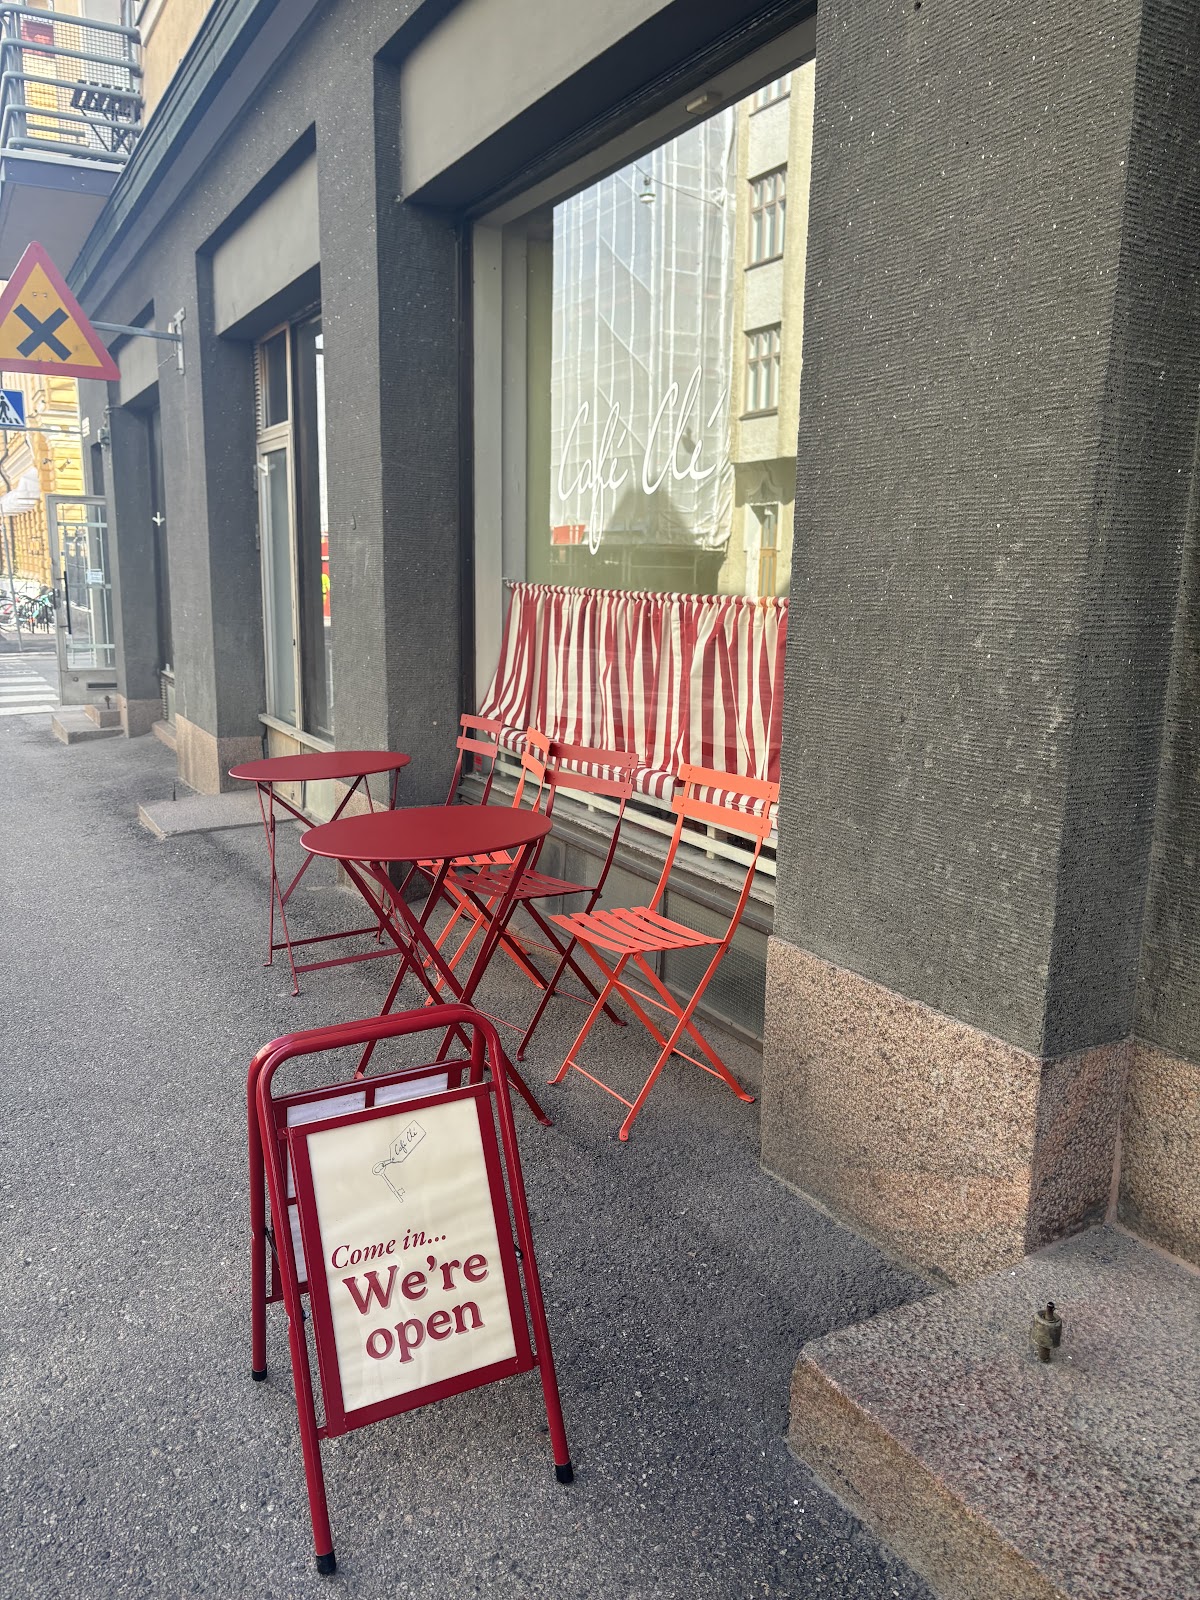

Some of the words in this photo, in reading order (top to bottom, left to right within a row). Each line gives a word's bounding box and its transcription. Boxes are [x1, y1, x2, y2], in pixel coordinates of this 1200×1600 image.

[557, 401, 628, 554] Café
[642, 365, 727, 494] Clé
[331, 1238, 396, 1269] Come
[402, 1229, 447, 1251] in...
[342, 1253, 488, 1315] We're
[365, 1301, 485, 1363] open
